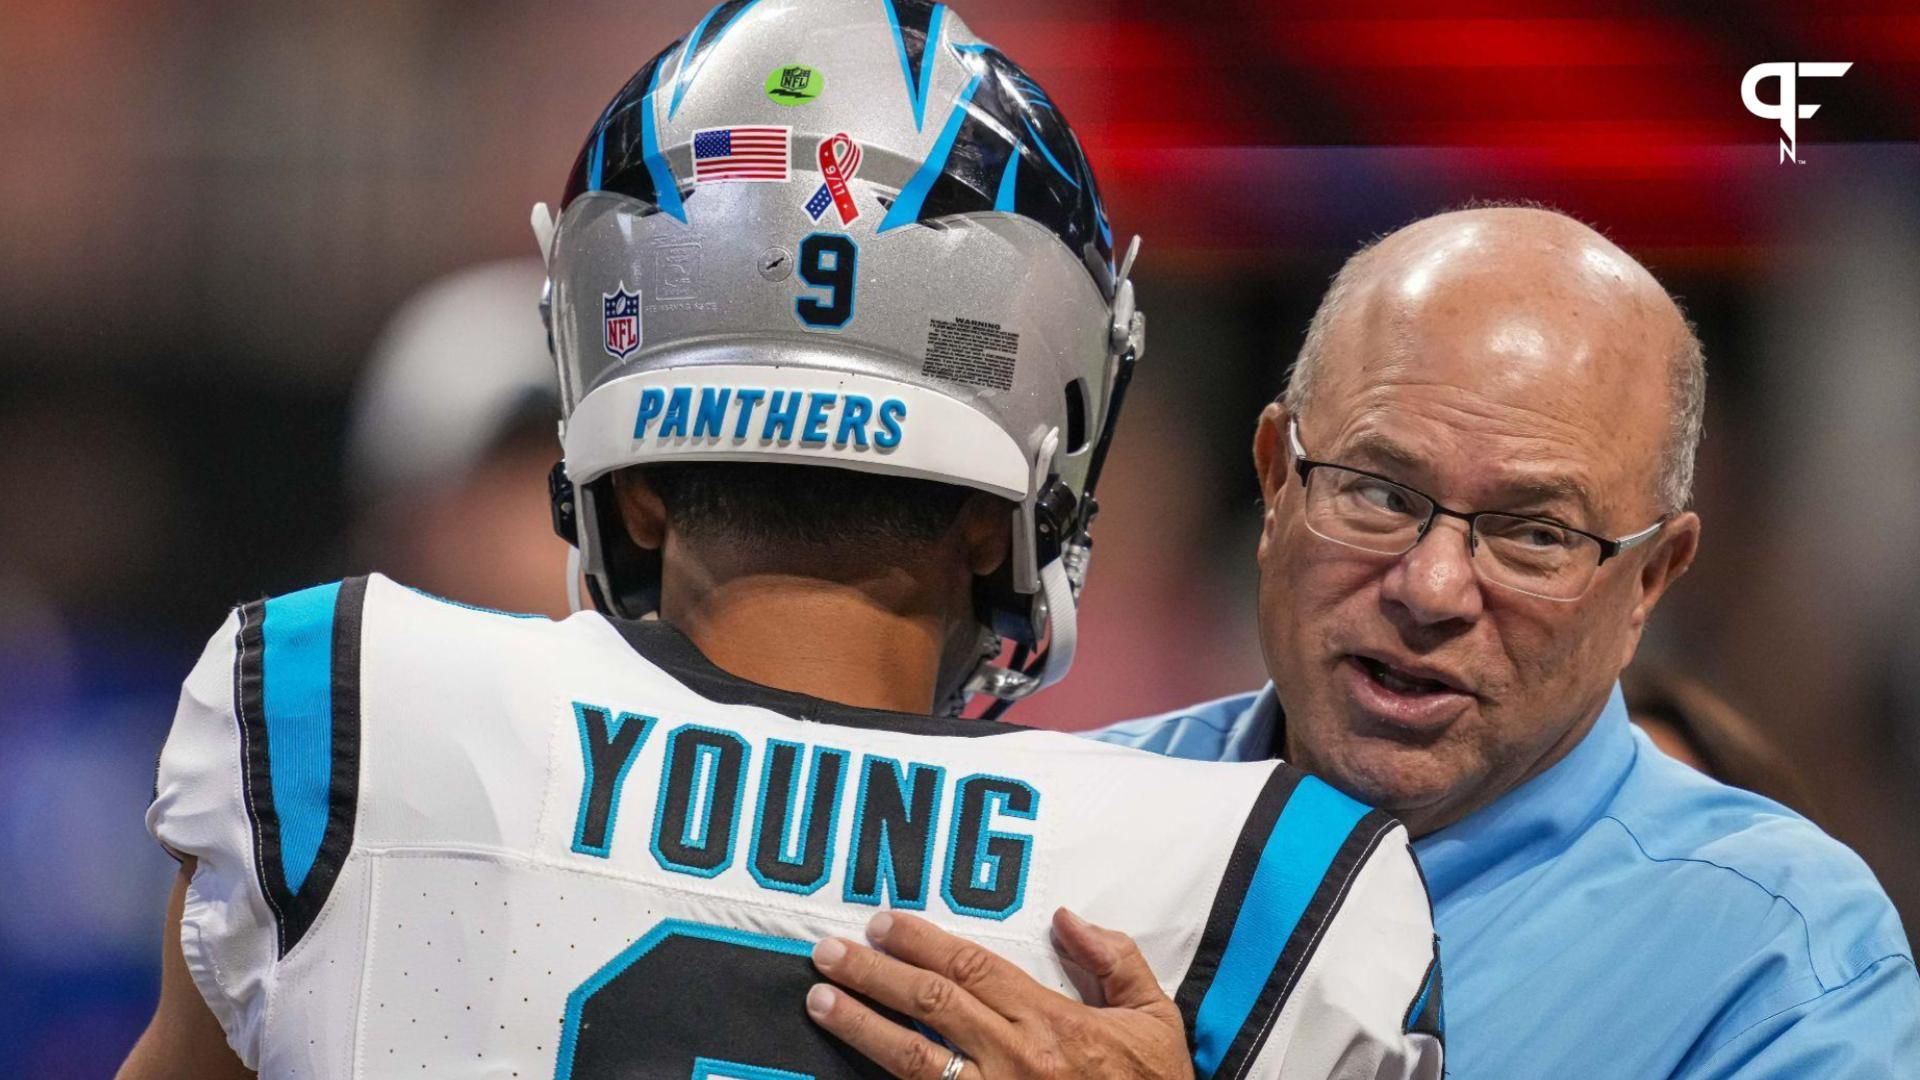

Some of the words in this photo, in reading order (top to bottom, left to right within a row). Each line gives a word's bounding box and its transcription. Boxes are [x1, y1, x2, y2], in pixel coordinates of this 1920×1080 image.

[783, 76, 807, 88] NFL
[825, 166, 846, 196] 9/11
[795, 232, 858, 331] 9
[607, 318, 637, 351] NFL
[955, 317, 1001, 330] WARNING
[633, 386, 907, 449] PANTHERS
[570, 701, 1041, 921] YOUNG
